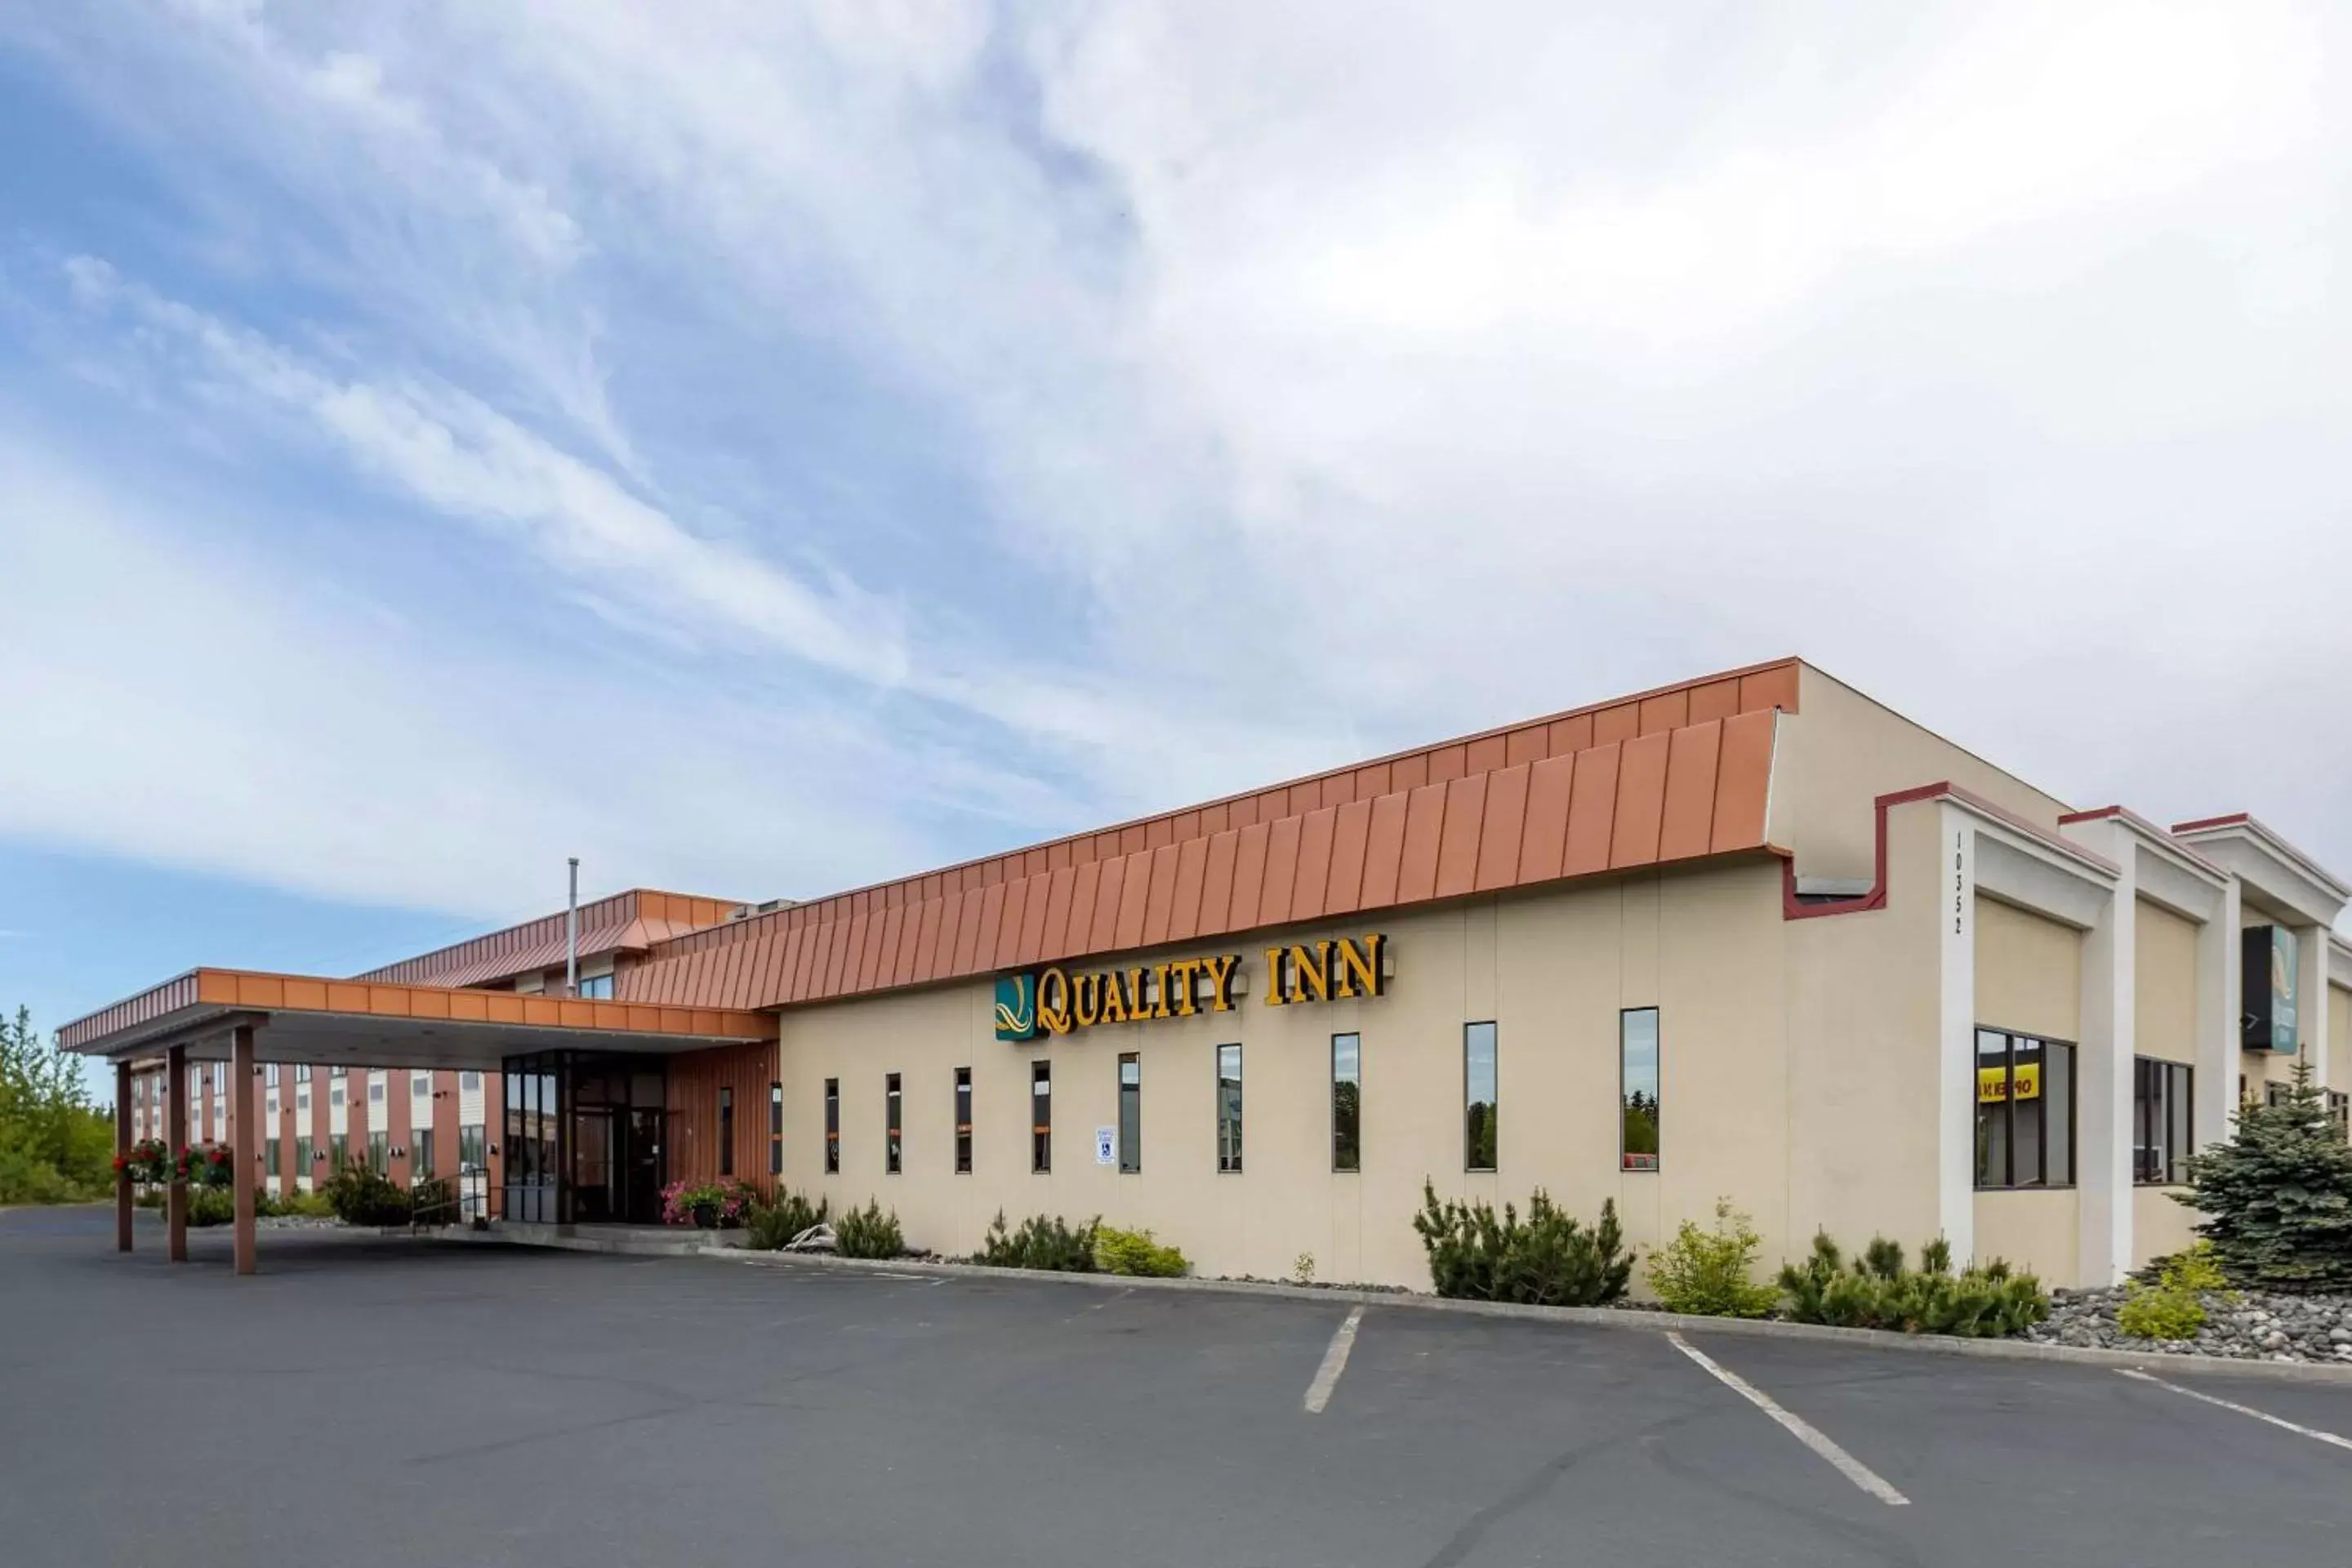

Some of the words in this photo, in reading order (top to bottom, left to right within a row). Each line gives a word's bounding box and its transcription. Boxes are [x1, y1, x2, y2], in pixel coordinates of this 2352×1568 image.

[1954, 830, 1962, 935] 10352
[1037, 955, 1239, 1034] QUALITY
[1266, 933, 1381, 1005] INN
